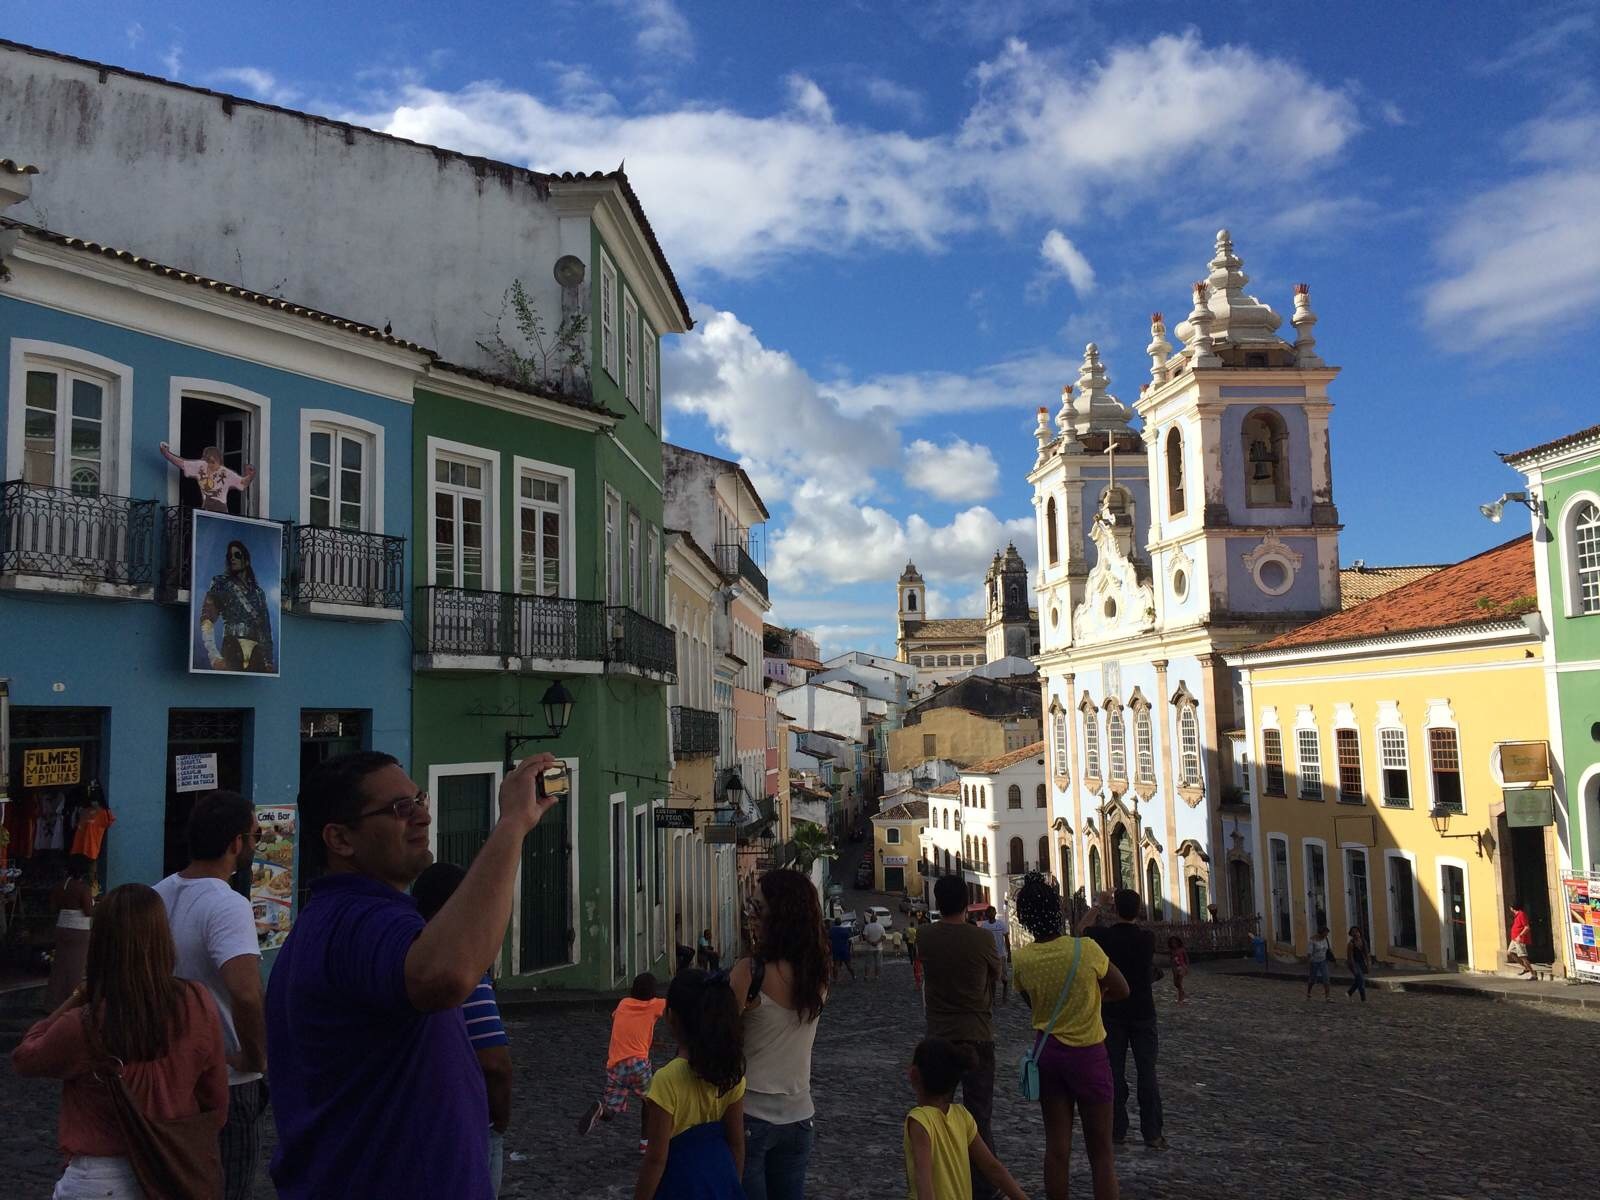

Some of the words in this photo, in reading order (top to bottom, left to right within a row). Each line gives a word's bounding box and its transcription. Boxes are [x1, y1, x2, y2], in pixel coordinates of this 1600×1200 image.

[26, 751, 78, 766] FILMES
[26, 775, 32, 785] E
[39, 773, 78, 785] PILHAS
[258, 812, 275, 821] Café
[278, 811, 290, 820] Bar
